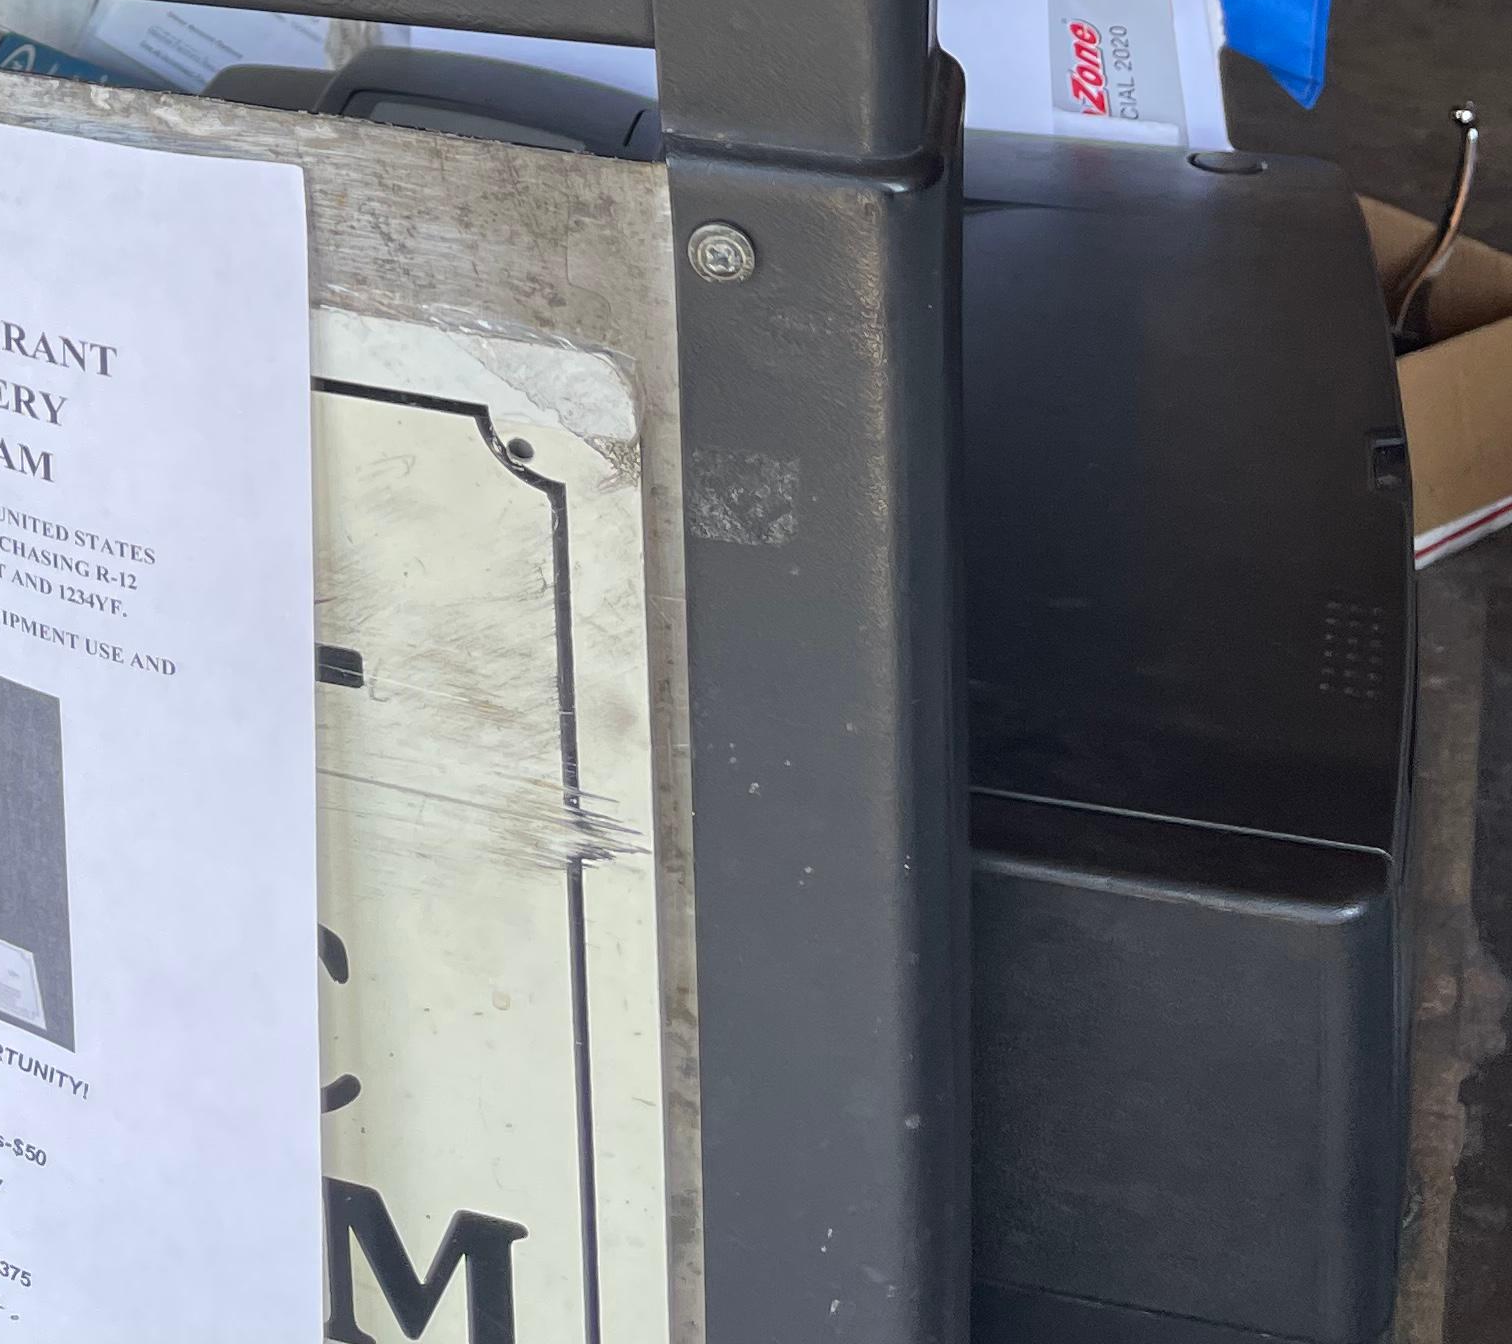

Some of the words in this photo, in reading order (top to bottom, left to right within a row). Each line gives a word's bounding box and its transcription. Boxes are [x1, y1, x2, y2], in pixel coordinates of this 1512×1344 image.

[1109, 25, 1133, 71] 2020
[74, 530, 155, 564] STATES
[12, 570, 52, 594] AND
[60, 584, 128, 618] 1234YF.
[96, 565, 137, 590] R-12
[86, 638, 124, 664] USE
[130, 652, 176, 675] AND
